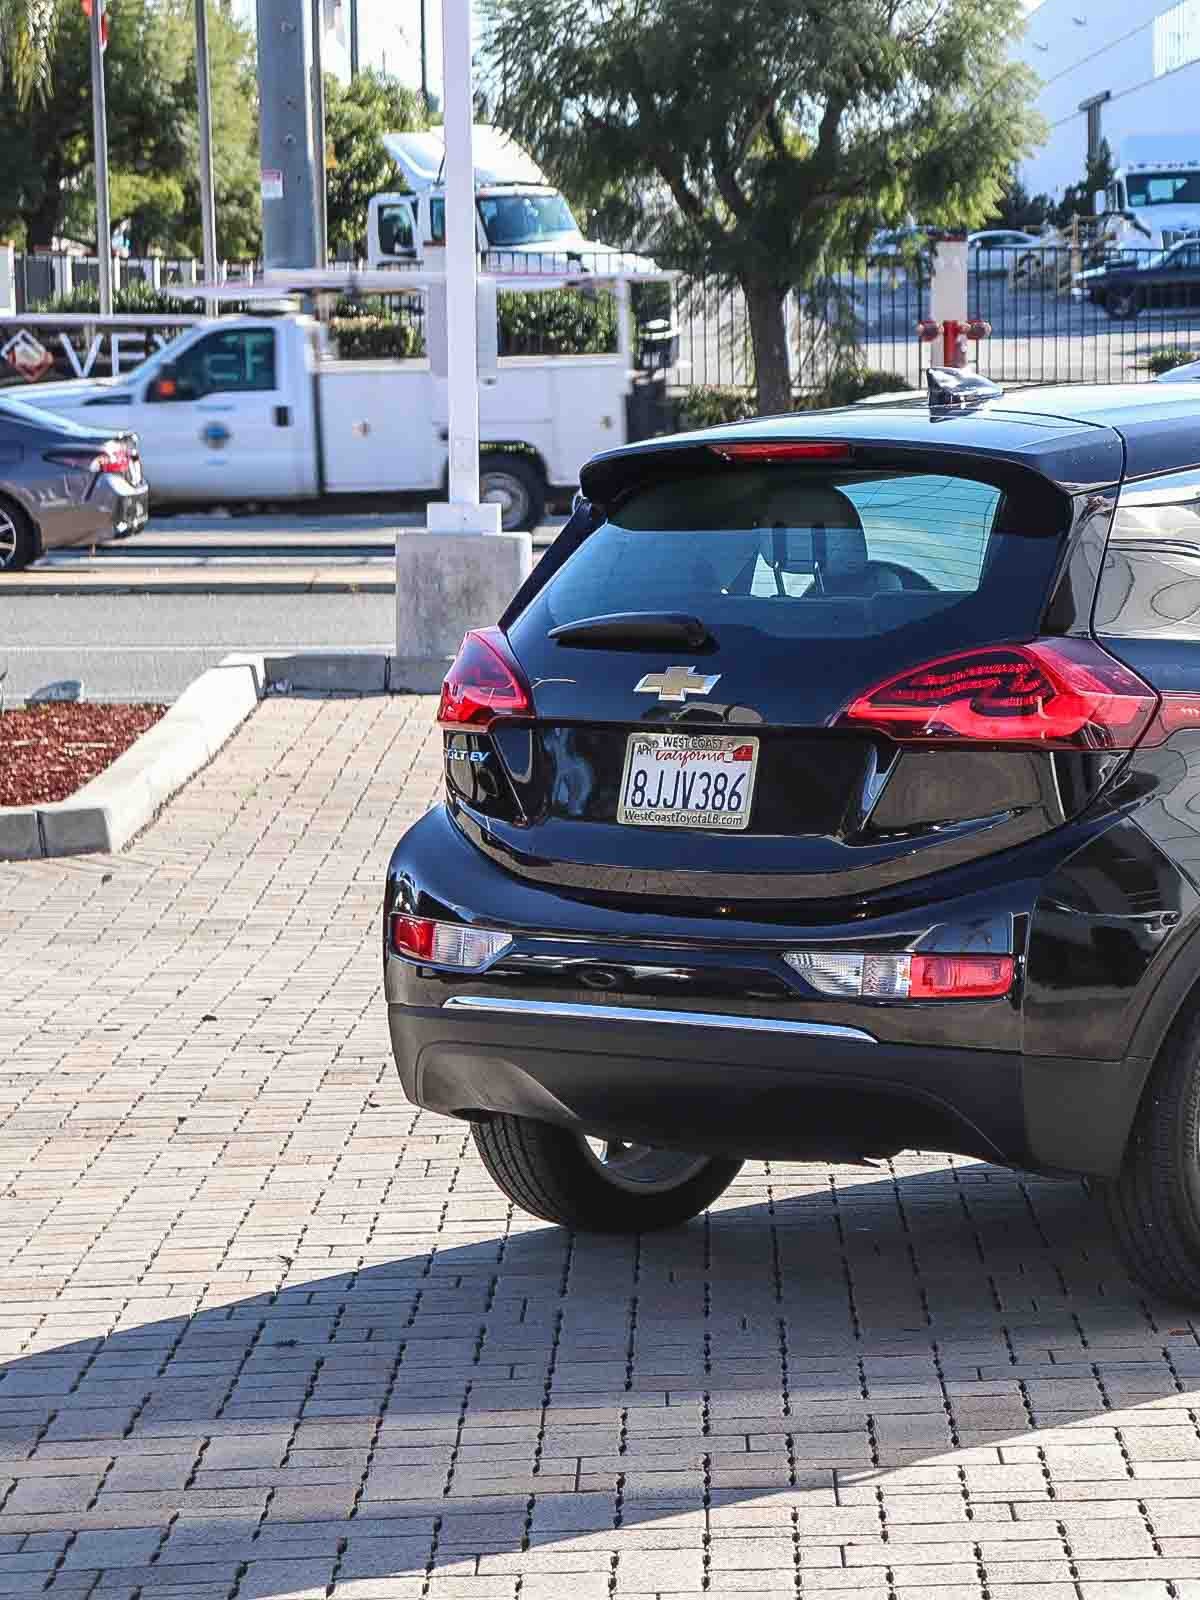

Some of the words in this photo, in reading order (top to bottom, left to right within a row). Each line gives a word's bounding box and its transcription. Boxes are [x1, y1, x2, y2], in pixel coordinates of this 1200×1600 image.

[663, 736, 689, 748] WEST
[691, 737, 723, 749] COAST
[470, 751, 490, 762] EV
[630, 769, 746, 811] 8JJV386
[624, 809, 743, 825] WestCoastToyotaLB.com
